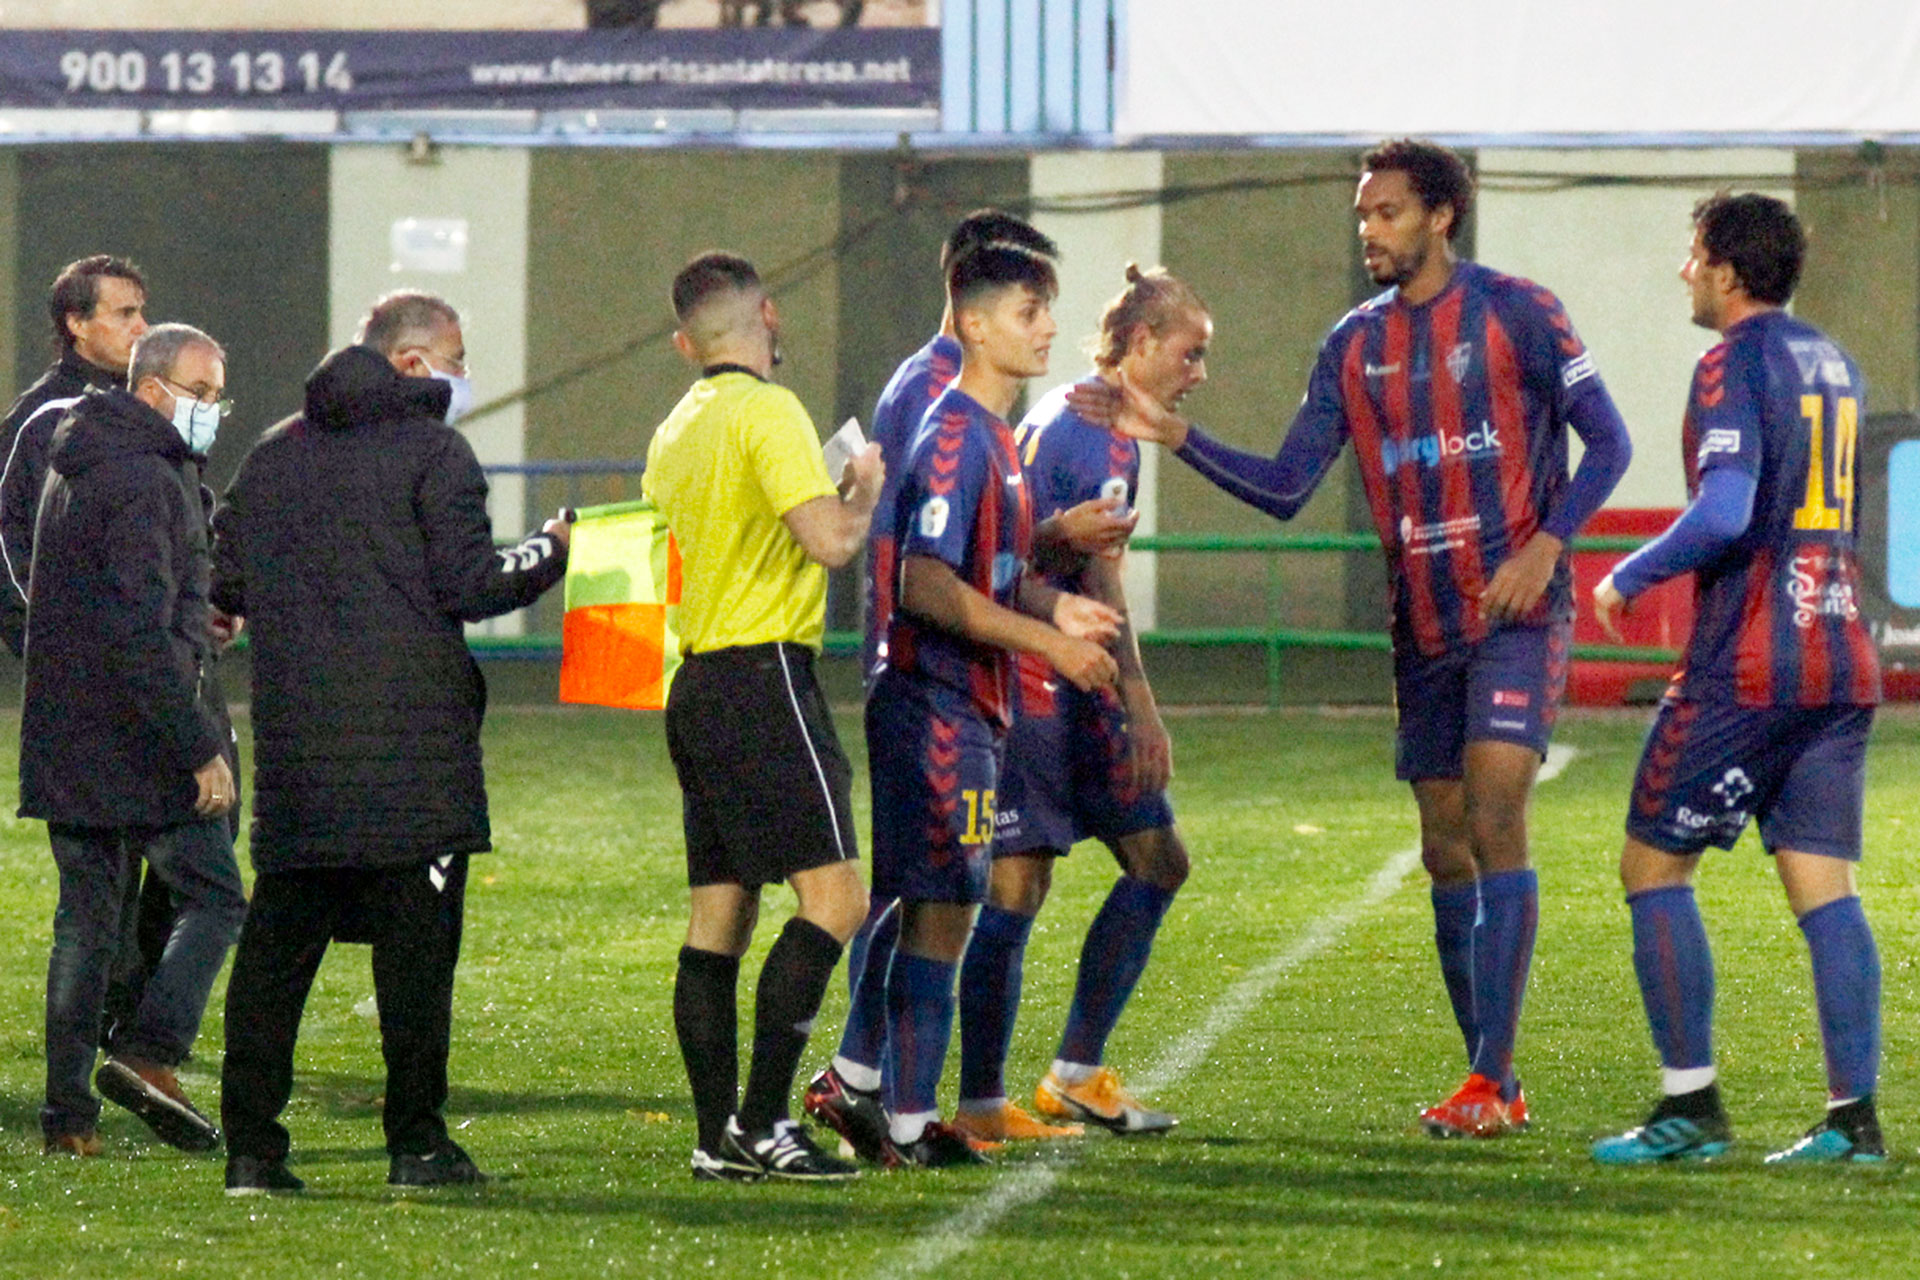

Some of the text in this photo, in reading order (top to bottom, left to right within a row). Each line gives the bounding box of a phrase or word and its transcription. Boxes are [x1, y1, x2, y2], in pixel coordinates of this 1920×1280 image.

[60, 51, 352, 93] 900 13 13 14
[1793, 395, 1857, 531] 14
[960, 790, 995, 844] 15
